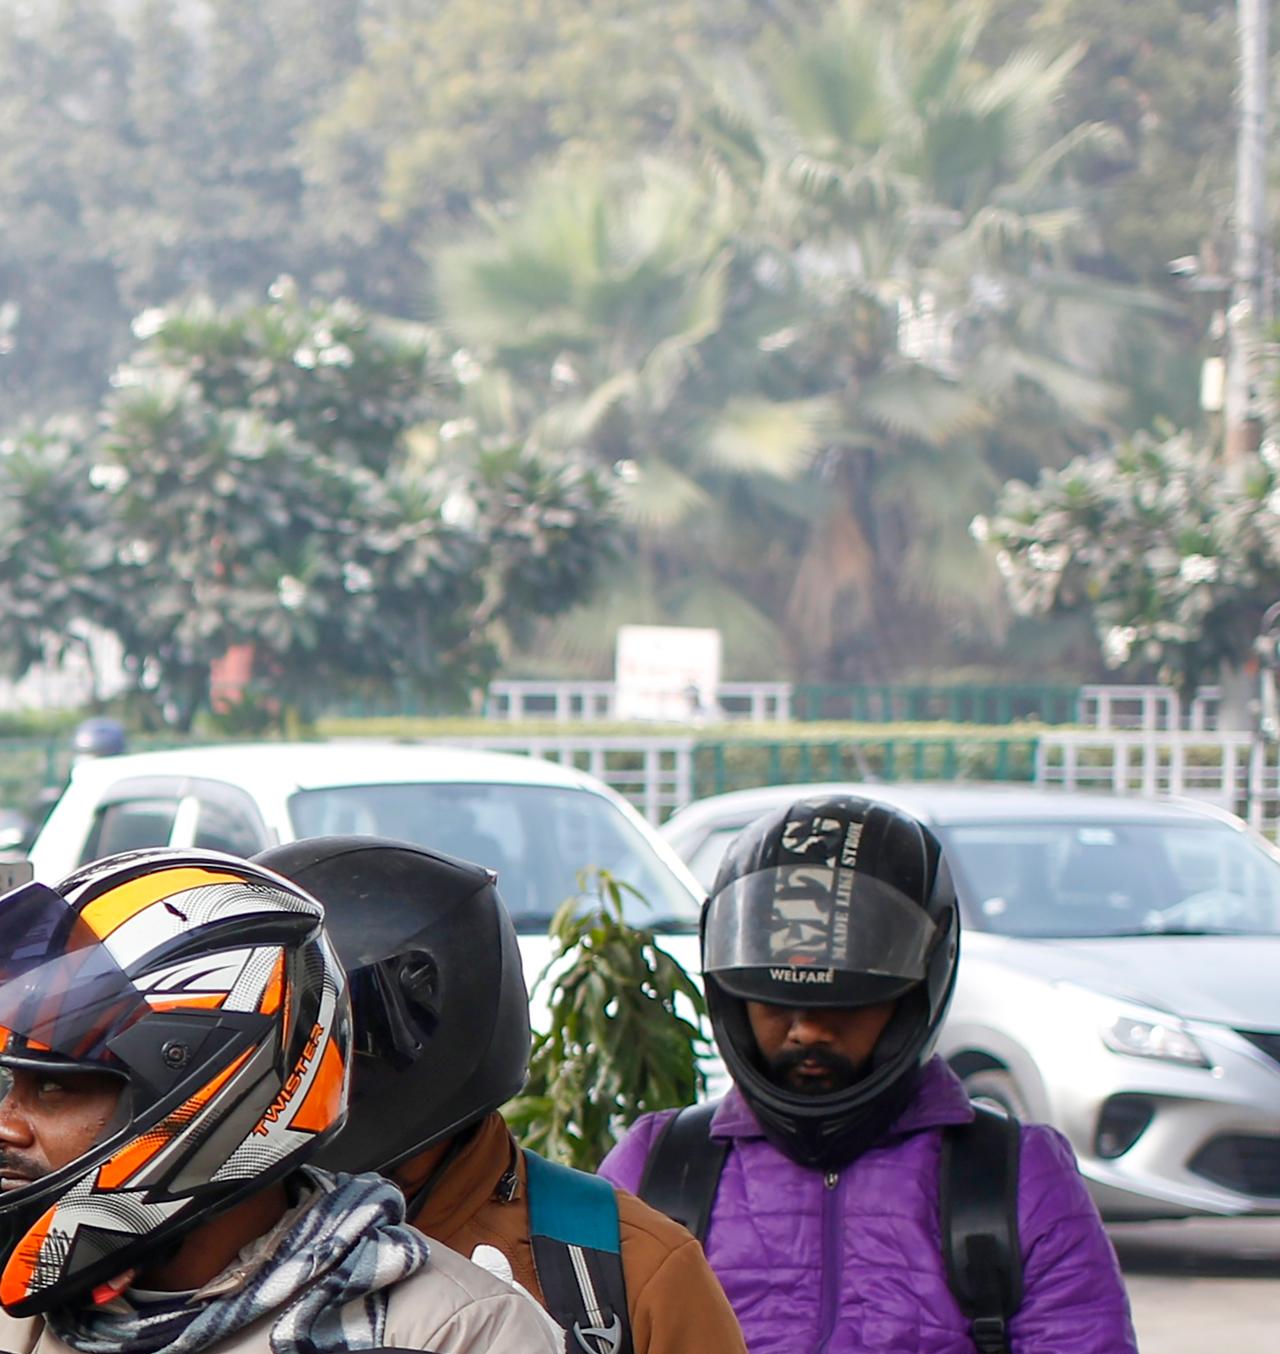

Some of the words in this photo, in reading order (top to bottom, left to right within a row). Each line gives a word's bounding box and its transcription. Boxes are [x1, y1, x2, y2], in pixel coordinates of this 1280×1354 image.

[832, 911, 849, 960] MADE
[769, 967, 835, 983] WELFARE
[253, 1023, 325, 1137] TWISTER
